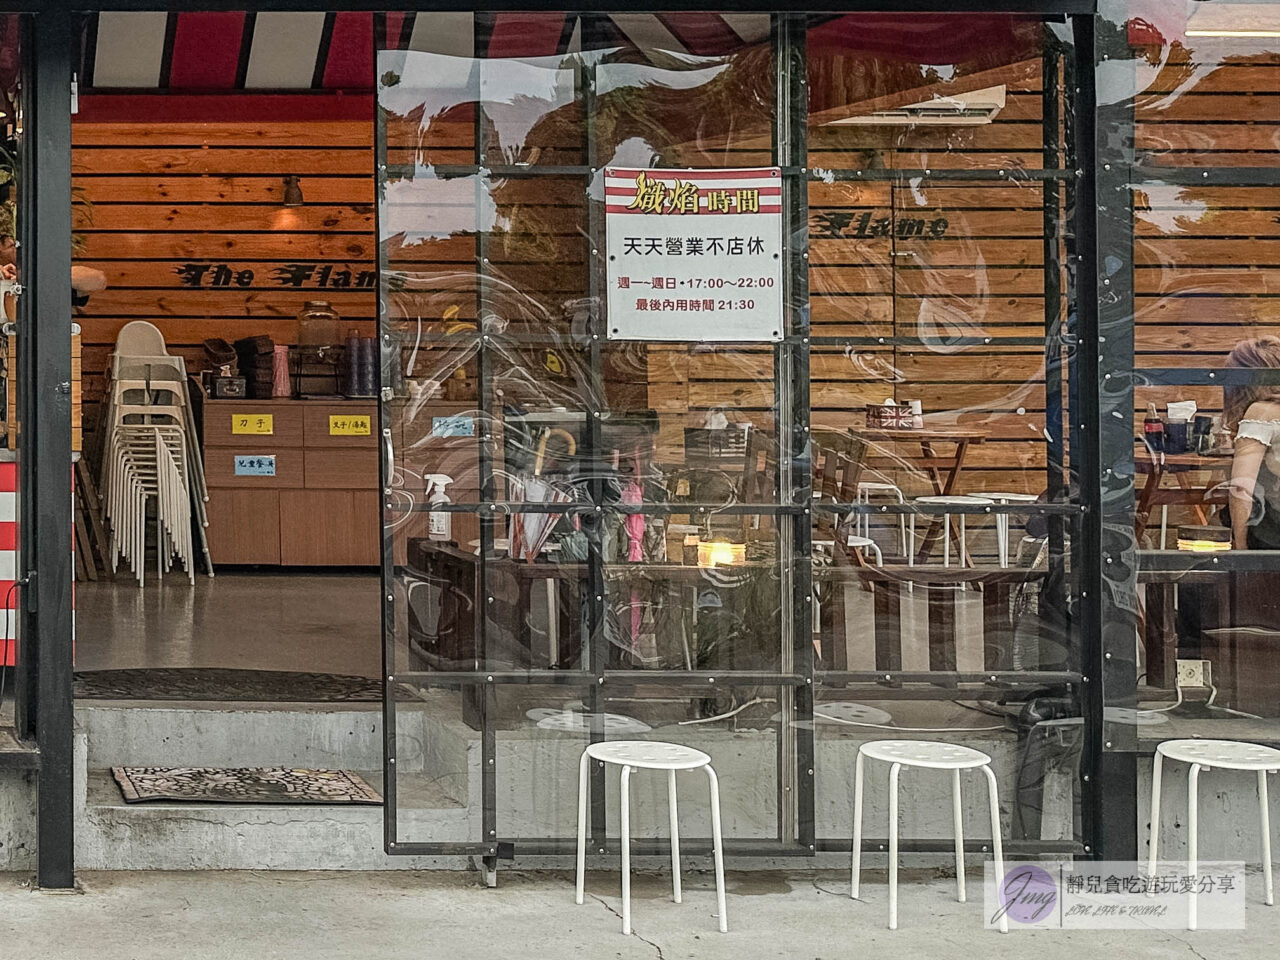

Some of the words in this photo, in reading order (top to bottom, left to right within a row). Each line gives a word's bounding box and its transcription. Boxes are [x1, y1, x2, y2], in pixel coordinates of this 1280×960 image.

[623, 237, 765, 257] 天天營業不店休
[172, 263, 255, 287] The
[718, 299, 755, 310] 21:30
